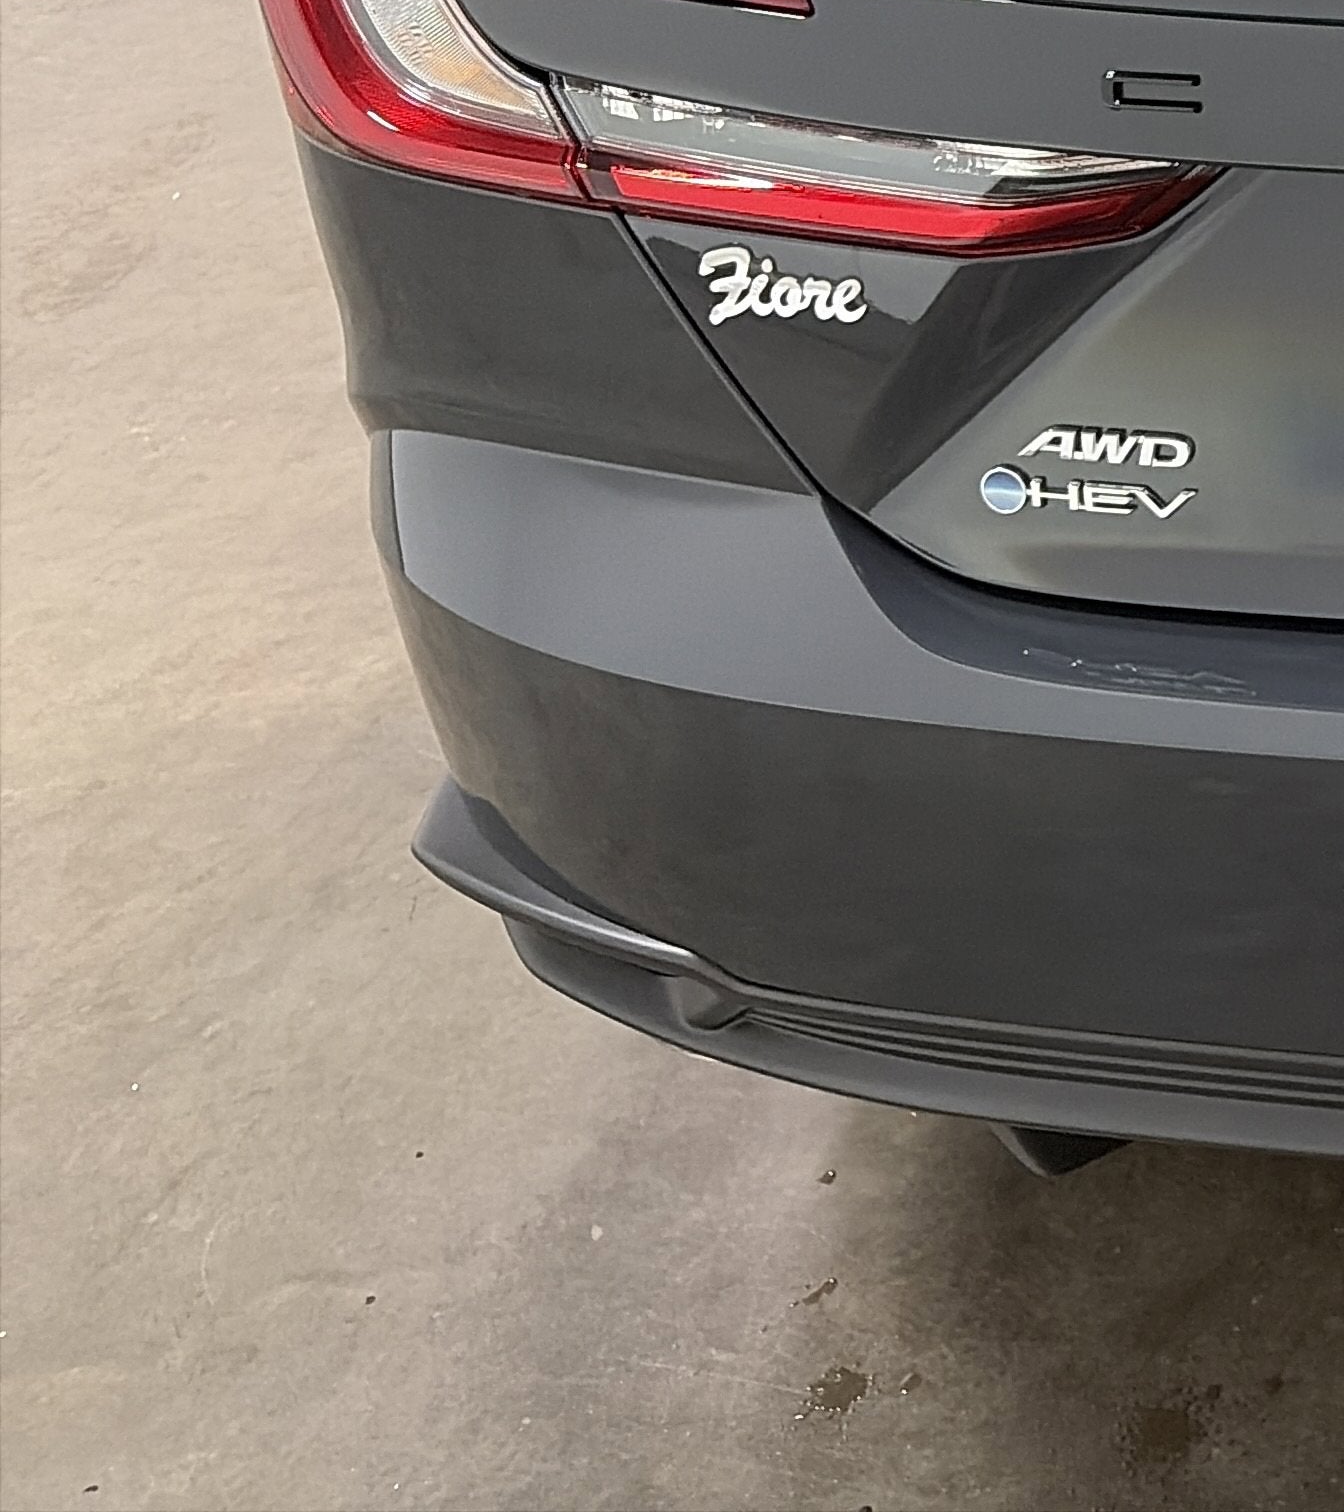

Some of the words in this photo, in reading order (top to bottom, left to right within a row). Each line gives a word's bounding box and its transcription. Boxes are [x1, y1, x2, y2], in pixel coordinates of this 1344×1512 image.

[698, 245, 868, 326] Fiore
[1017, 424, 1196, 468] AWD
[1028, 477, 1199, 519] HEV
